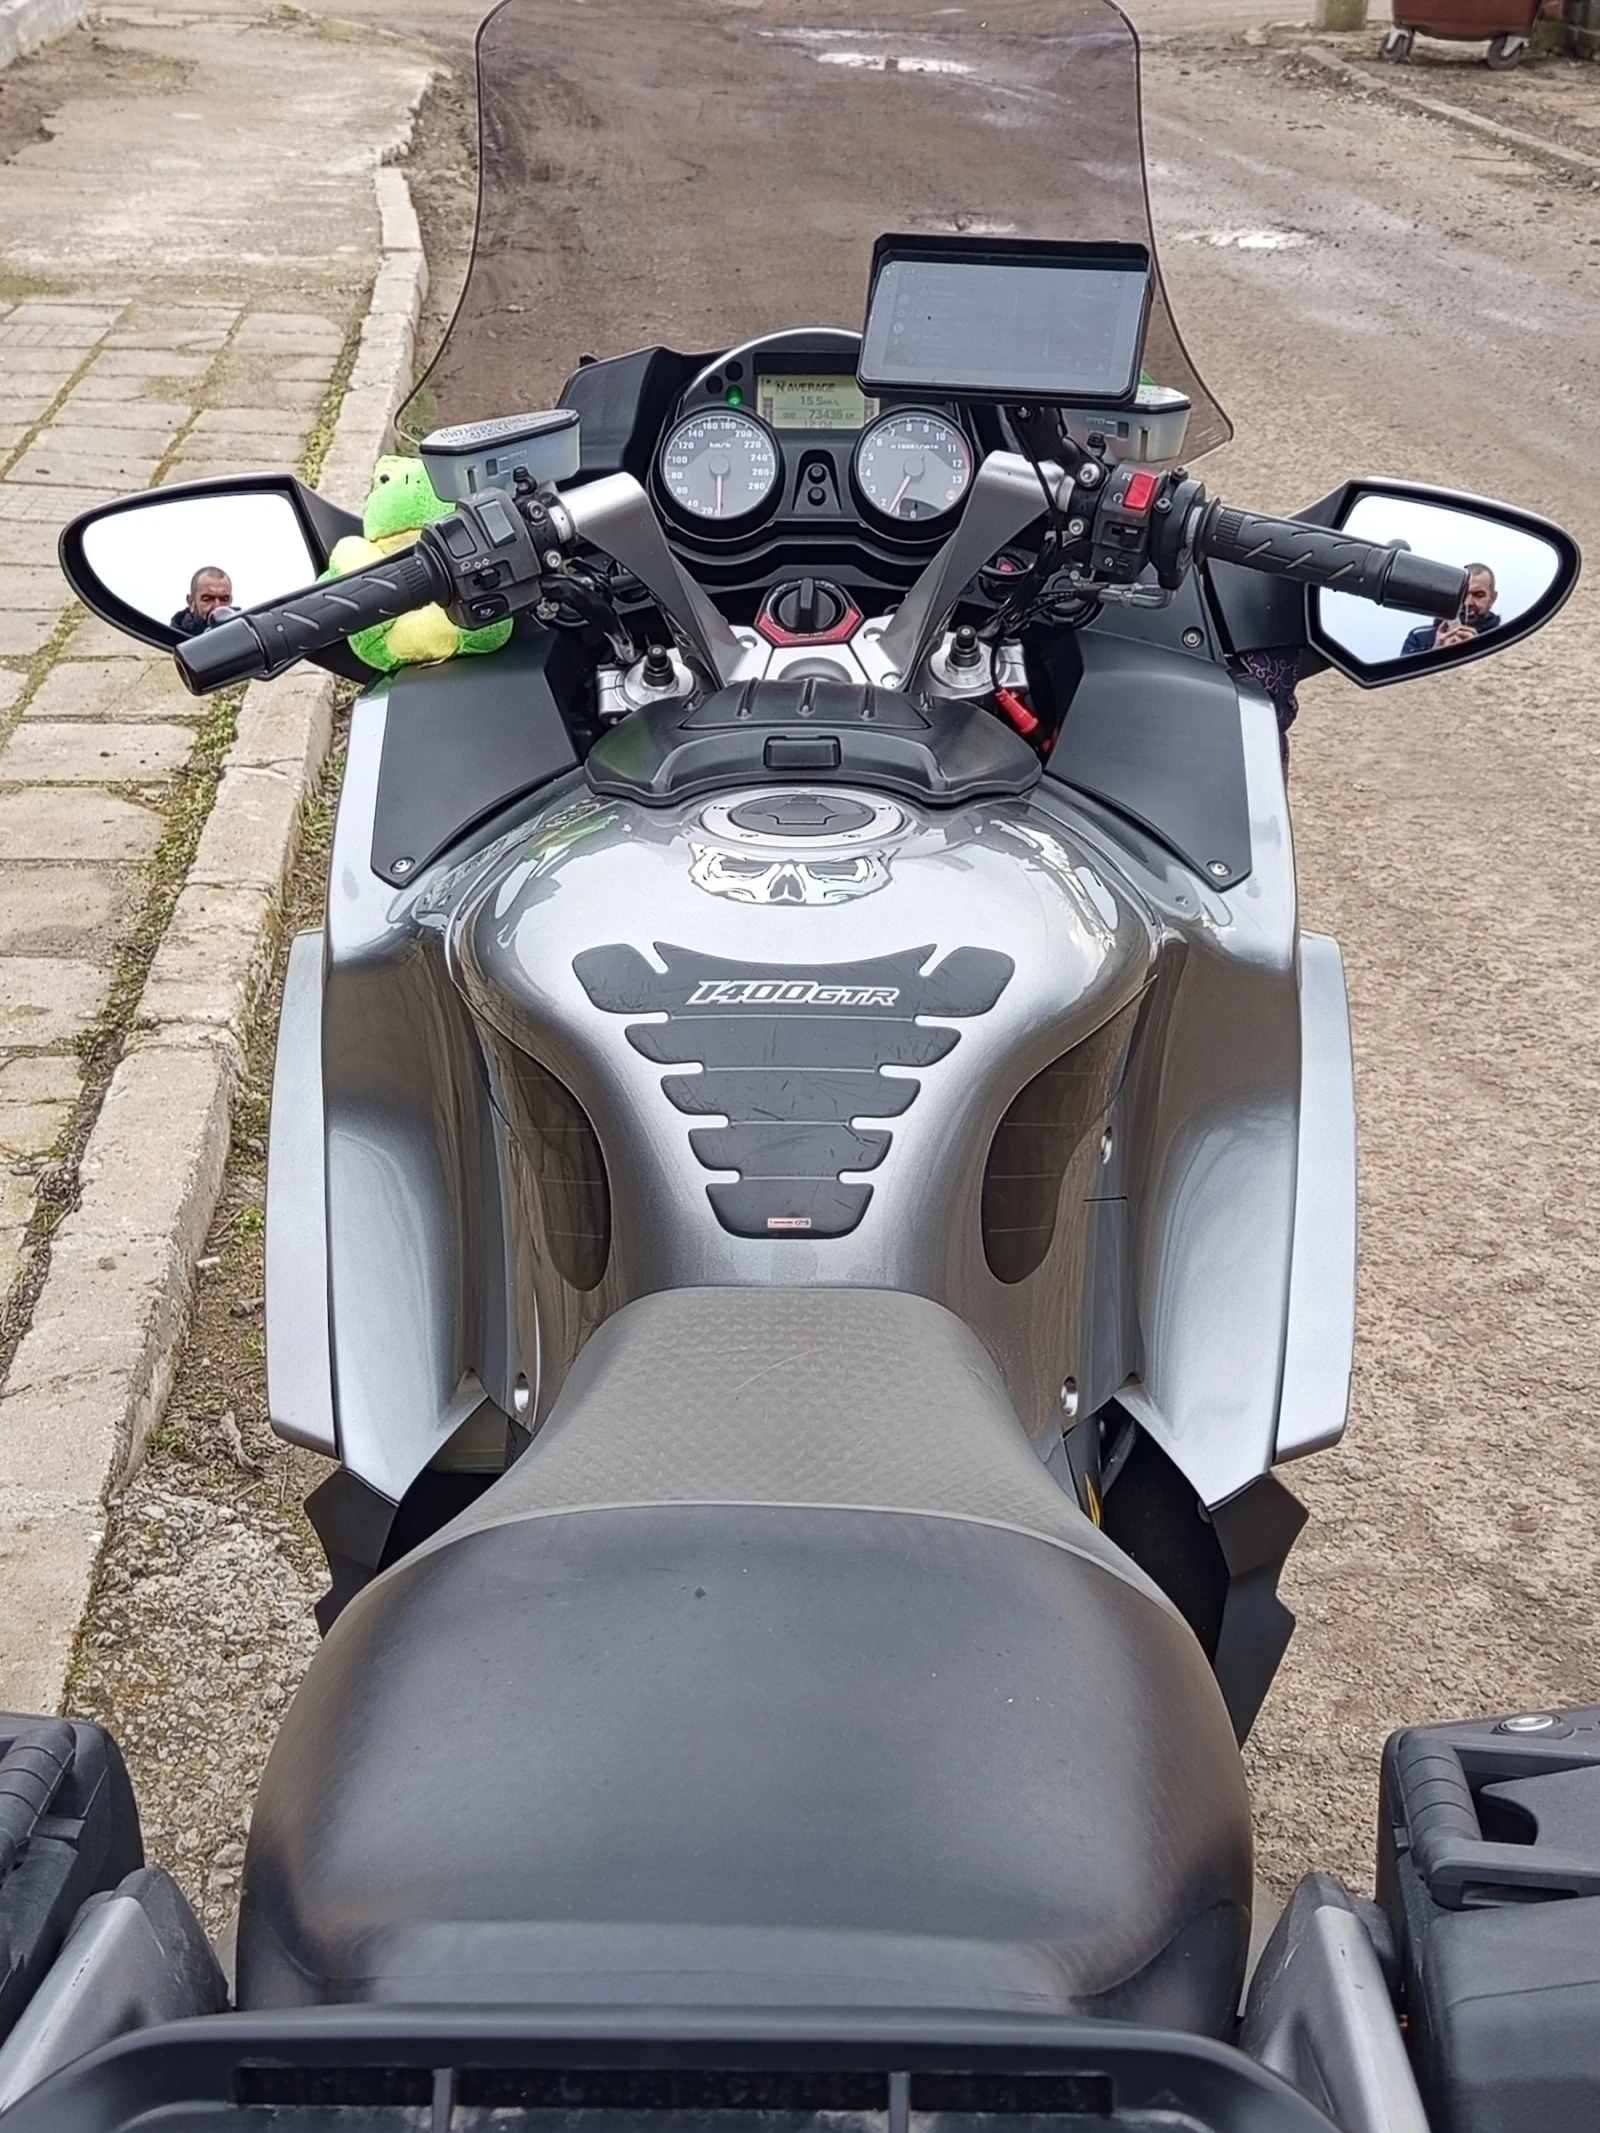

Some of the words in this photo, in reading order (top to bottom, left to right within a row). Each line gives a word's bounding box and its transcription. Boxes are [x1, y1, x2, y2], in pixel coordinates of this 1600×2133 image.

[787, 383, 836, 392] AVERAGE
[702, 422, 718, 430] 160
[720, 422, 737, 430] 180
[688, 430, 704, 438] 140
[735, 430, 752, 438] 200
[890, 429, 895, 437] 7
[936, 432, 946, 441] 10
[744, 441, 761, 449] 220
[947, 445, 957, 453] 11
[672, 456, 688, 464] 100
[868, 453, 874, 461] 5
[952, 460, 963, 468] 12
[671, 472, 683, 480] 80
[752, 468, 770, 476] 260
[865, 469, 871, 477] 4
[952, 475, 962, 484] 13
[748, 482, 766, 490] 280
[870, 485, 876, 493] 3
[880, 498, 887, 507] 2
[701, 507, 713, 515] 20
